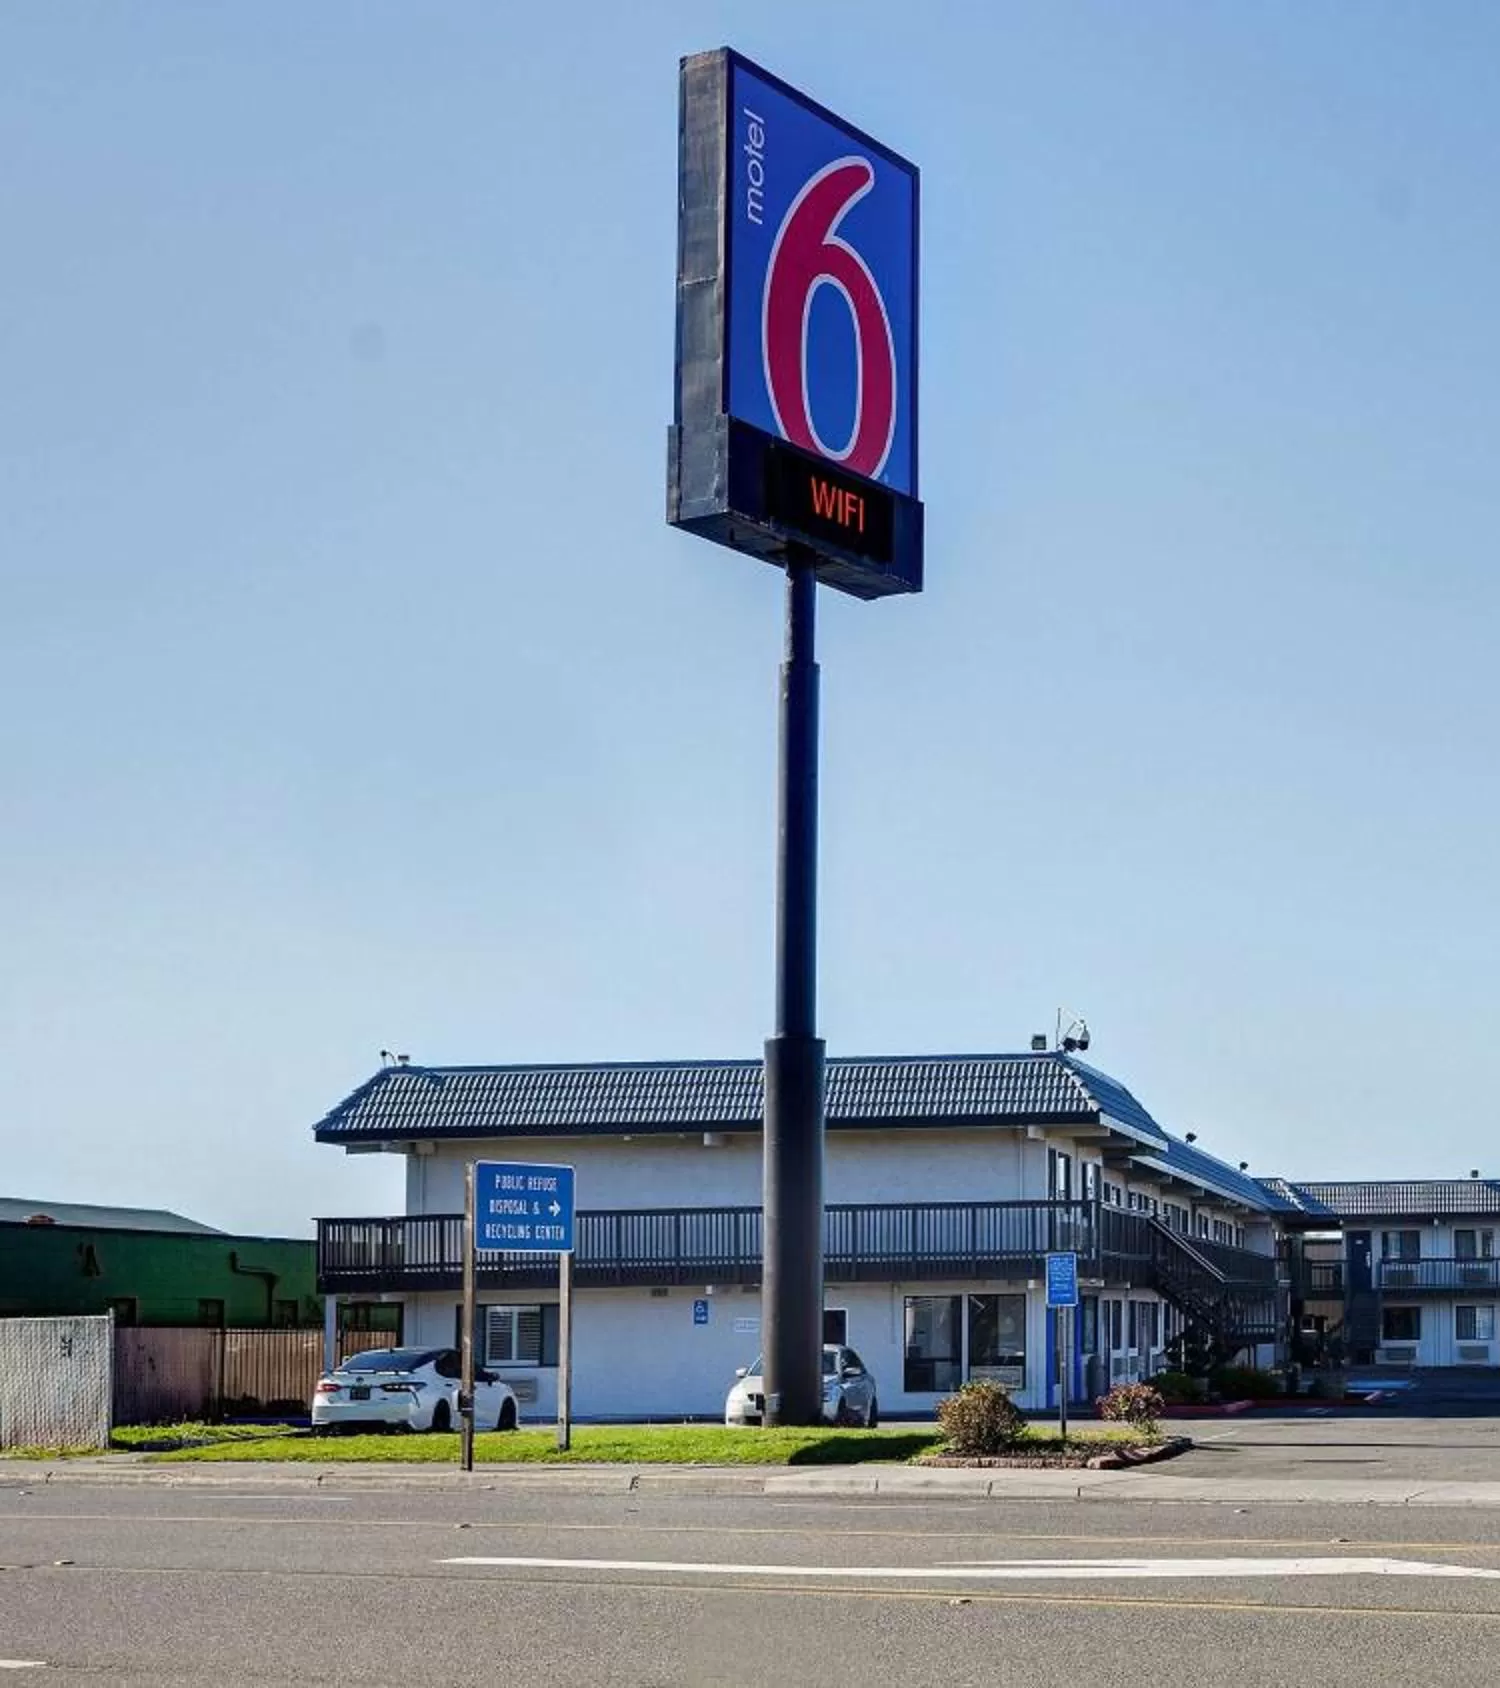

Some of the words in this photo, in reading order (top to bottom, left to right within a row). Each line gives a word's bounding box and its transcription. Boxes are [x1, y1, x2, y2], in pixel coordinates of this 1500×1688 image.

[743, 107, 765, 225] motel
[761, 155, 897, 482] 6
[810, 474, 865, 534] WIFI
[495, 1174, 525, 1189] PUBLIC
[527, 1175, 557, 1191] REFUSE
[490, 1200, 528, 1215] DISPOSAL
[533, 1201, 540, 1215] &
[485, 1223, 531, 1239] RECYCLING
[535, 1225, 564, 1240] CENTER
